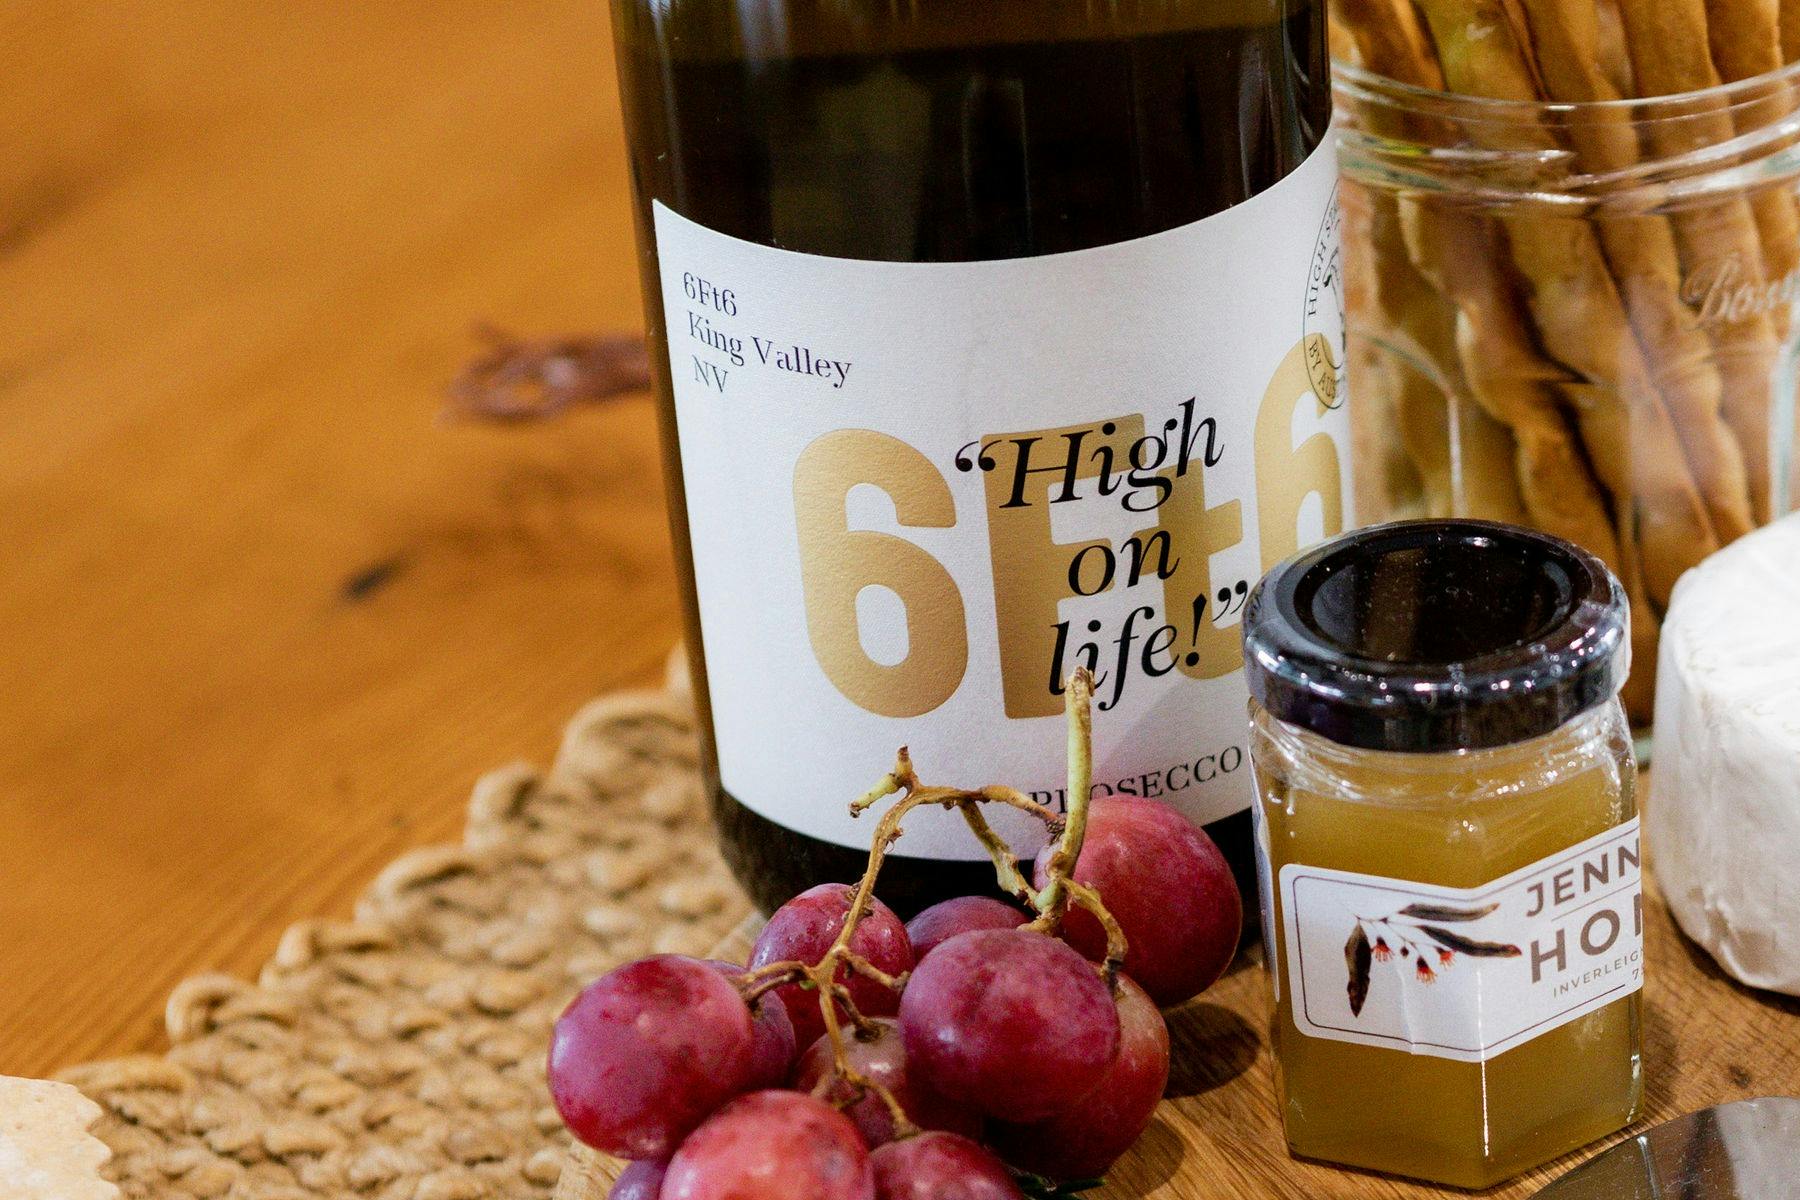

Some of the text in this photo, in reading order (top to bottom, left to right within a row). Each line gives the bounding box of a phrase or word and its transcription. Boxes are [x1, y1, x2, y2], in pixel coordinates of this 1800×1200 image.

[683, 271, 738, 317] 6Ft6
[687, 311, 853, 389] King Valley
[692, 354, 729, 393] NV
[955, 396, 1224, 513] “High
[792, 332, 1344, 722] 6Ft6
[1067, 529, 1181, 597] on
[1526, 837, 1640, 917] JENN
[1553, 946, 1642, 998] INVERLEIG
